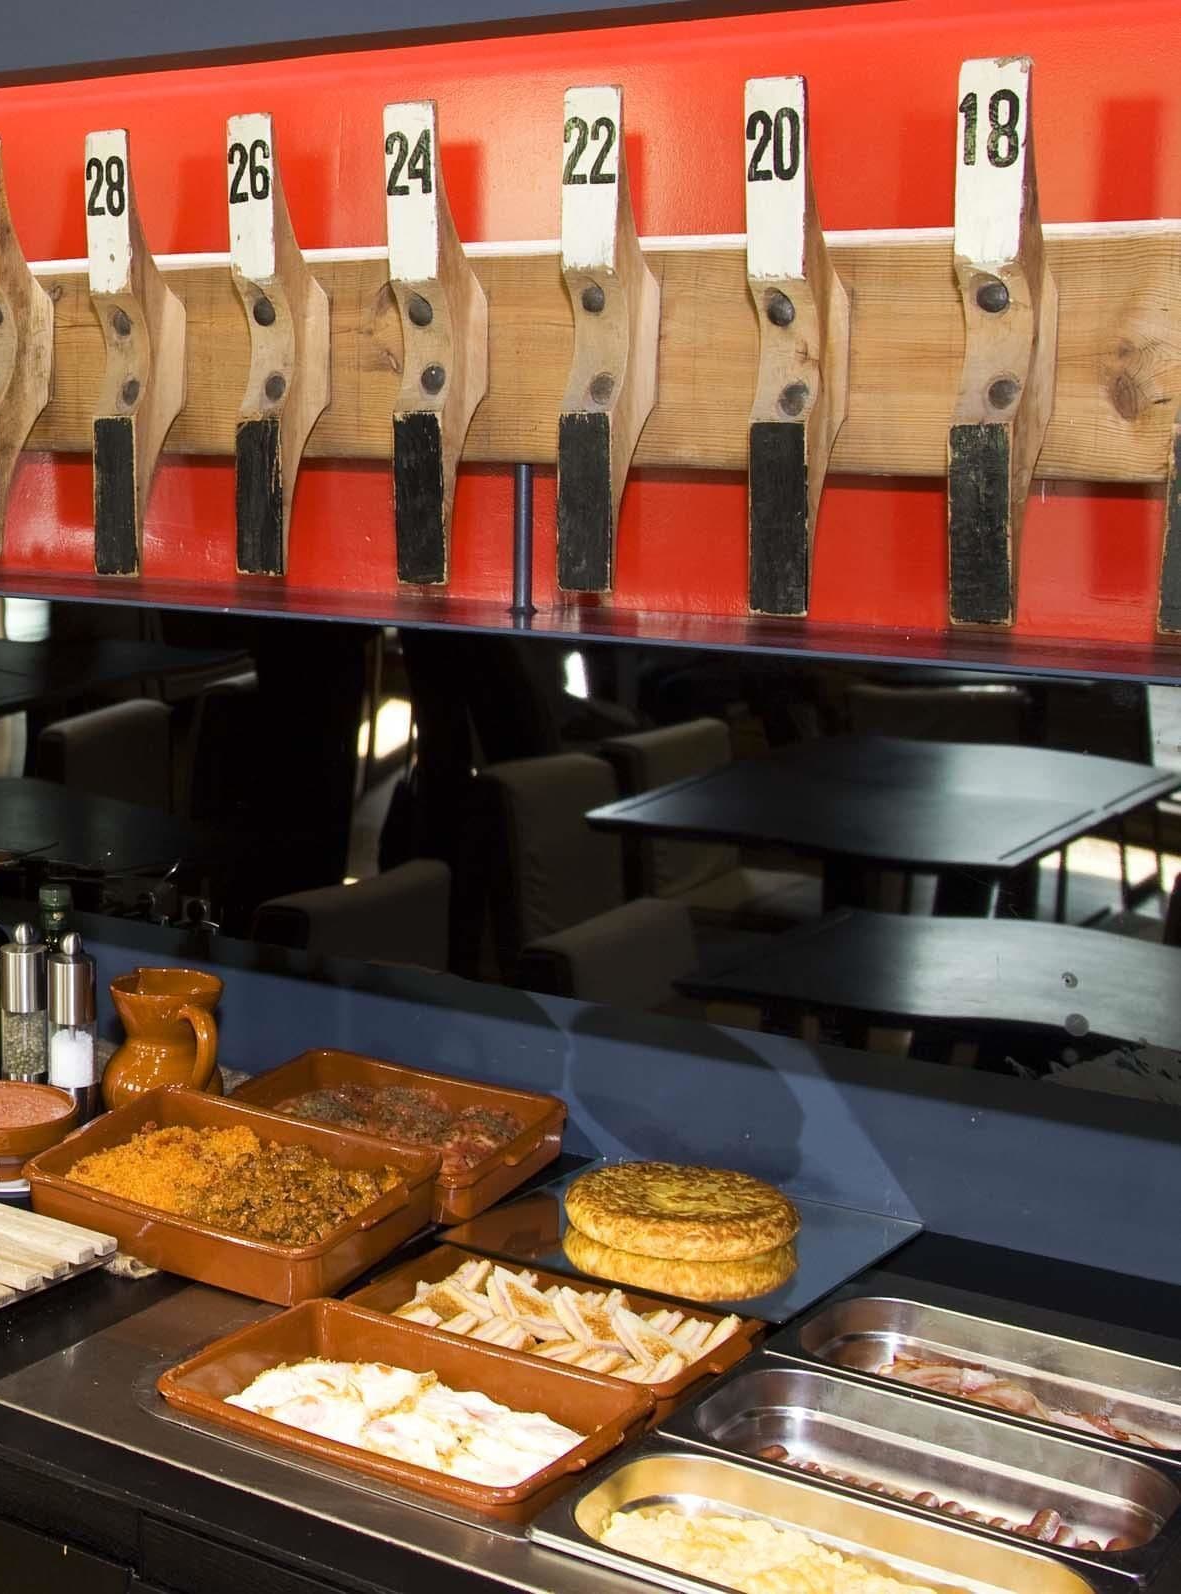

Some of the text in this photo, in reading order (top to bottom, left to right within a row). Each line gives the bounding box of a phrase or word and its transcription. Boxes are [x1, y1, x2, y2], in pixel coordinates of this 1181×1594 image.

[385, 128, 433, 196] 24
[562, 116, 616, 185] 22
[745, 108, 801, 183] 20
[958, 89, 1022, 167] 18
[85, 157, 126, 217] 28
[227, 139, 270, 205] 26
